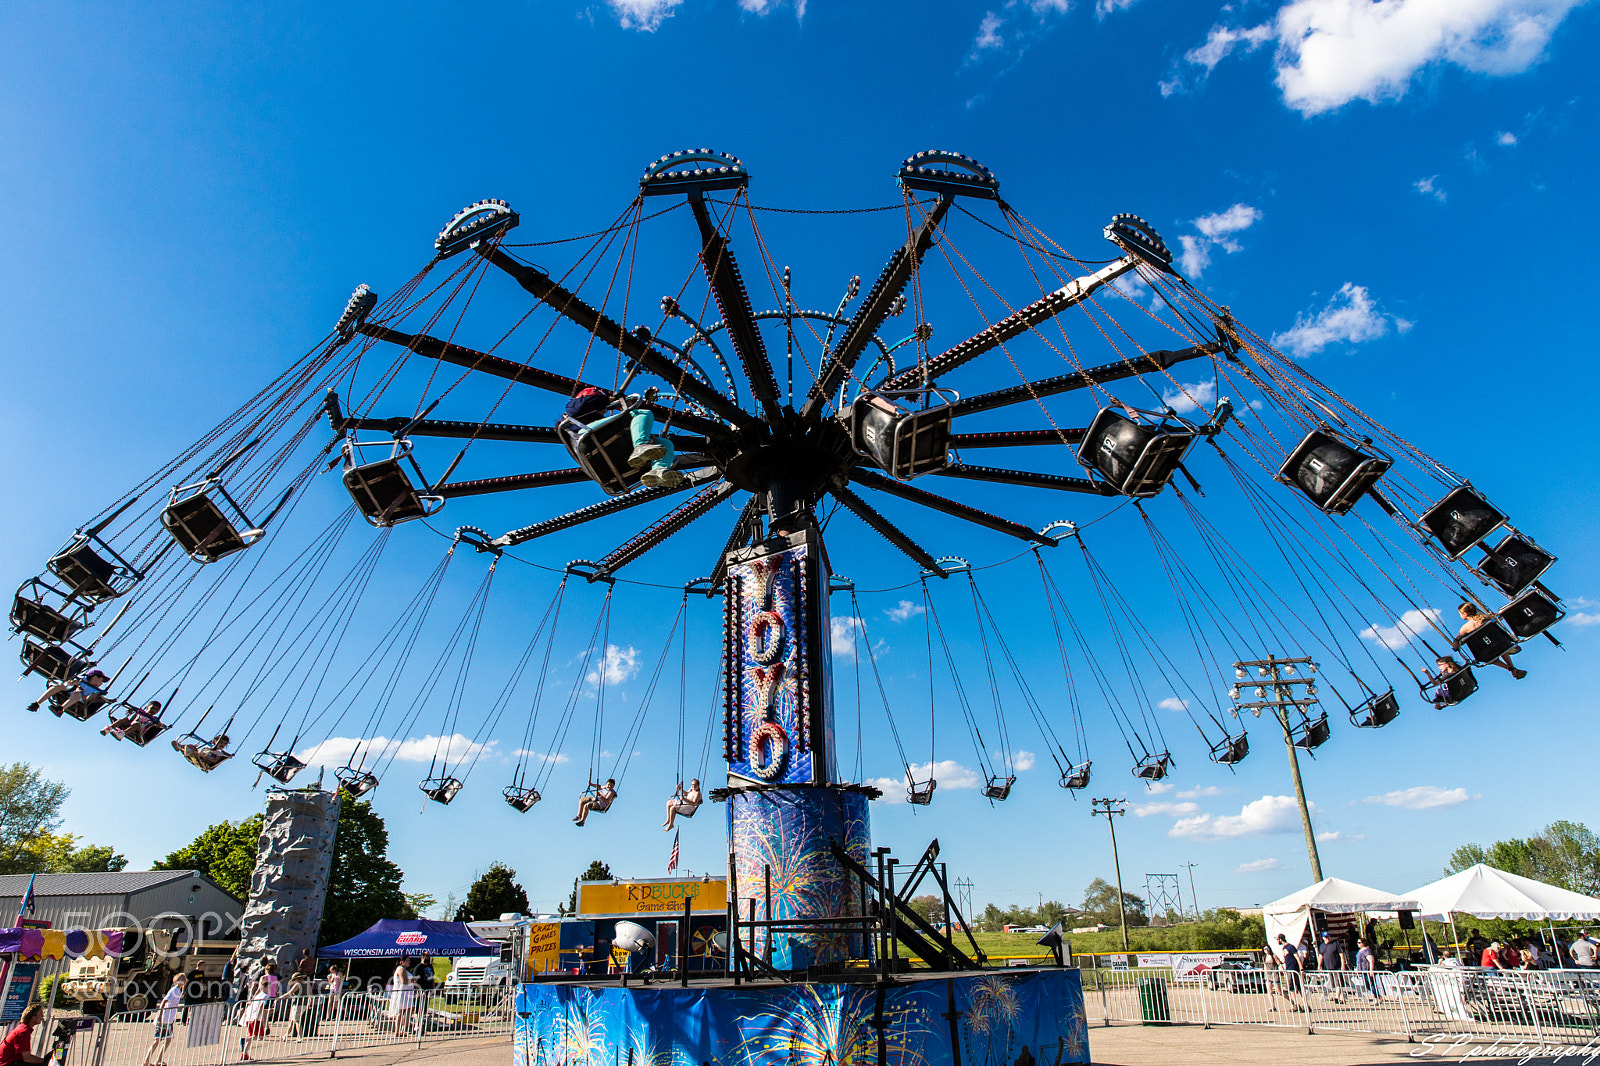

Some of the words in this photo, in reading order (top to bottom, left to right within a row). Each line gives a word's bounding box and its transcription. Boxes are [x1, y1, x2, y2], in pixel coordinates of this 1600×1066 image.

[1101, 437, 1116, 454] 32
[750, 554, 788, 782] YOYO
[628, 883, 700, 900] KIDBUCK$
[636, 902, 665, 912] Game
[667, 901, 692, 911] Sho
[531, 923, 555, 934] CRAZY
[533, 930, 556, 943] GAMES
[384, 948, 404, 956] ARMY
[405, 948, 439, 956] NATIONAL
[441, 948, 466, 956] GUARD
[530, 942, 556, 955] PRIZES
